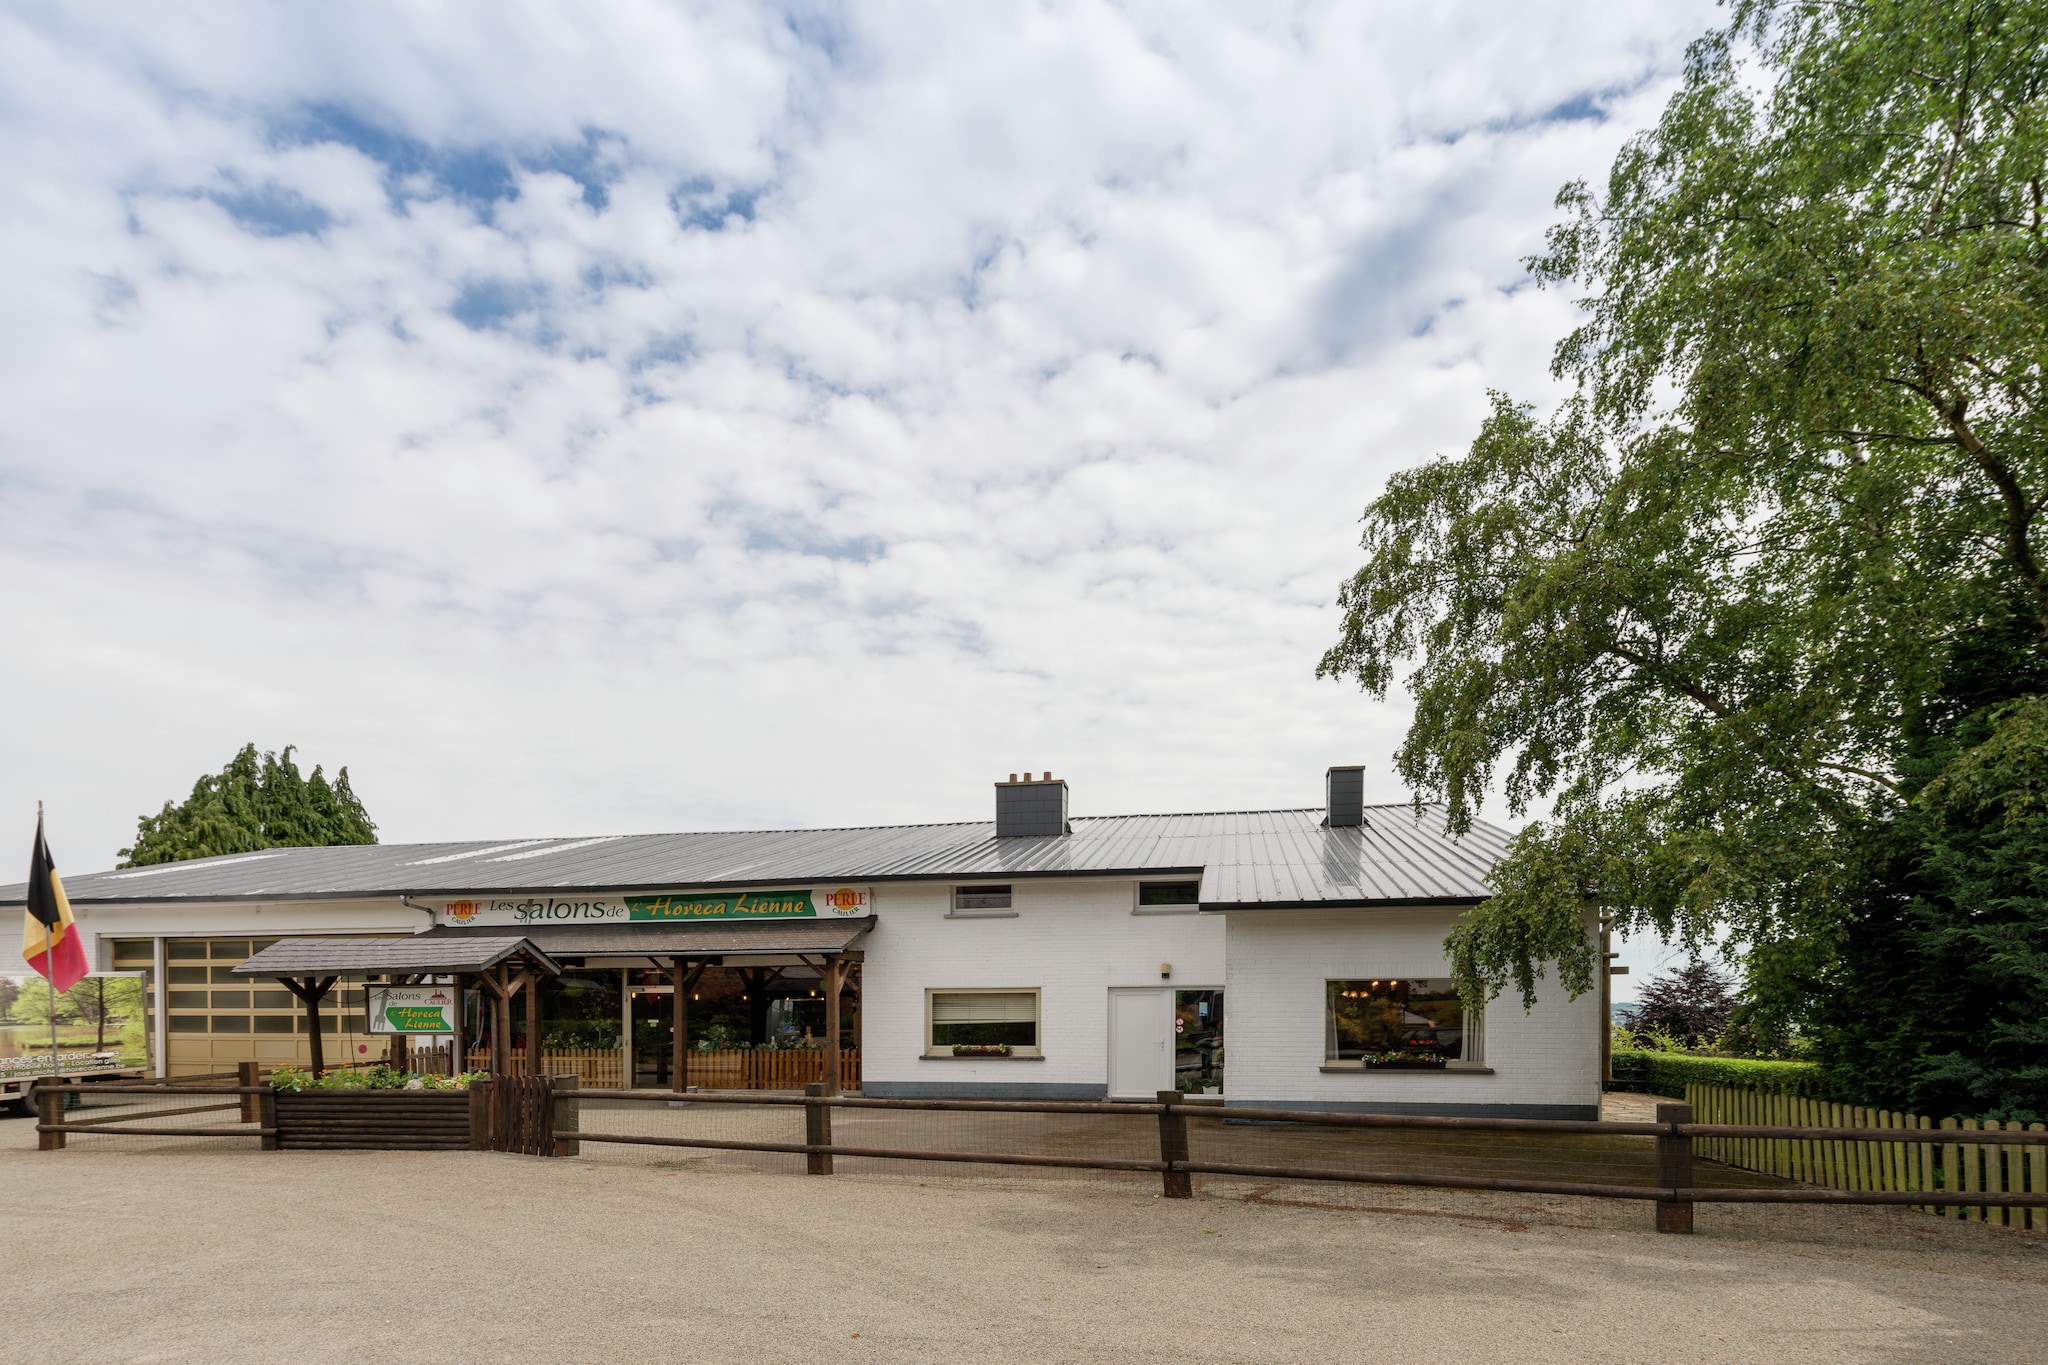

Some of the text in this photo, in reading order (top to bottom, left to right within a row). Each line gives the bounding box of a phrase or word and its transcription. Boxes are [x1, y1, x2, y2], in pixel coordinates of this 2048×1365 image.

[825, 893, 867, 906] PERLE
[446, 903, 482, 915] PERLE
[489, 900, 514, 911] Les
[606, 906, 624, 918] de
[631, 902, 643, 912] L'
[646, 897, 726, 916] Horeca
[732, 893, 804, 914] Lienne
[832, 907, 860, 916] CAULIER
[451, 915, 476, 925] CAULIER
[386, 992, 421, 1000] Salons
[397, 1008, 441, 1018] Horeca
[404, 1018, 441, 1029] Lienne
